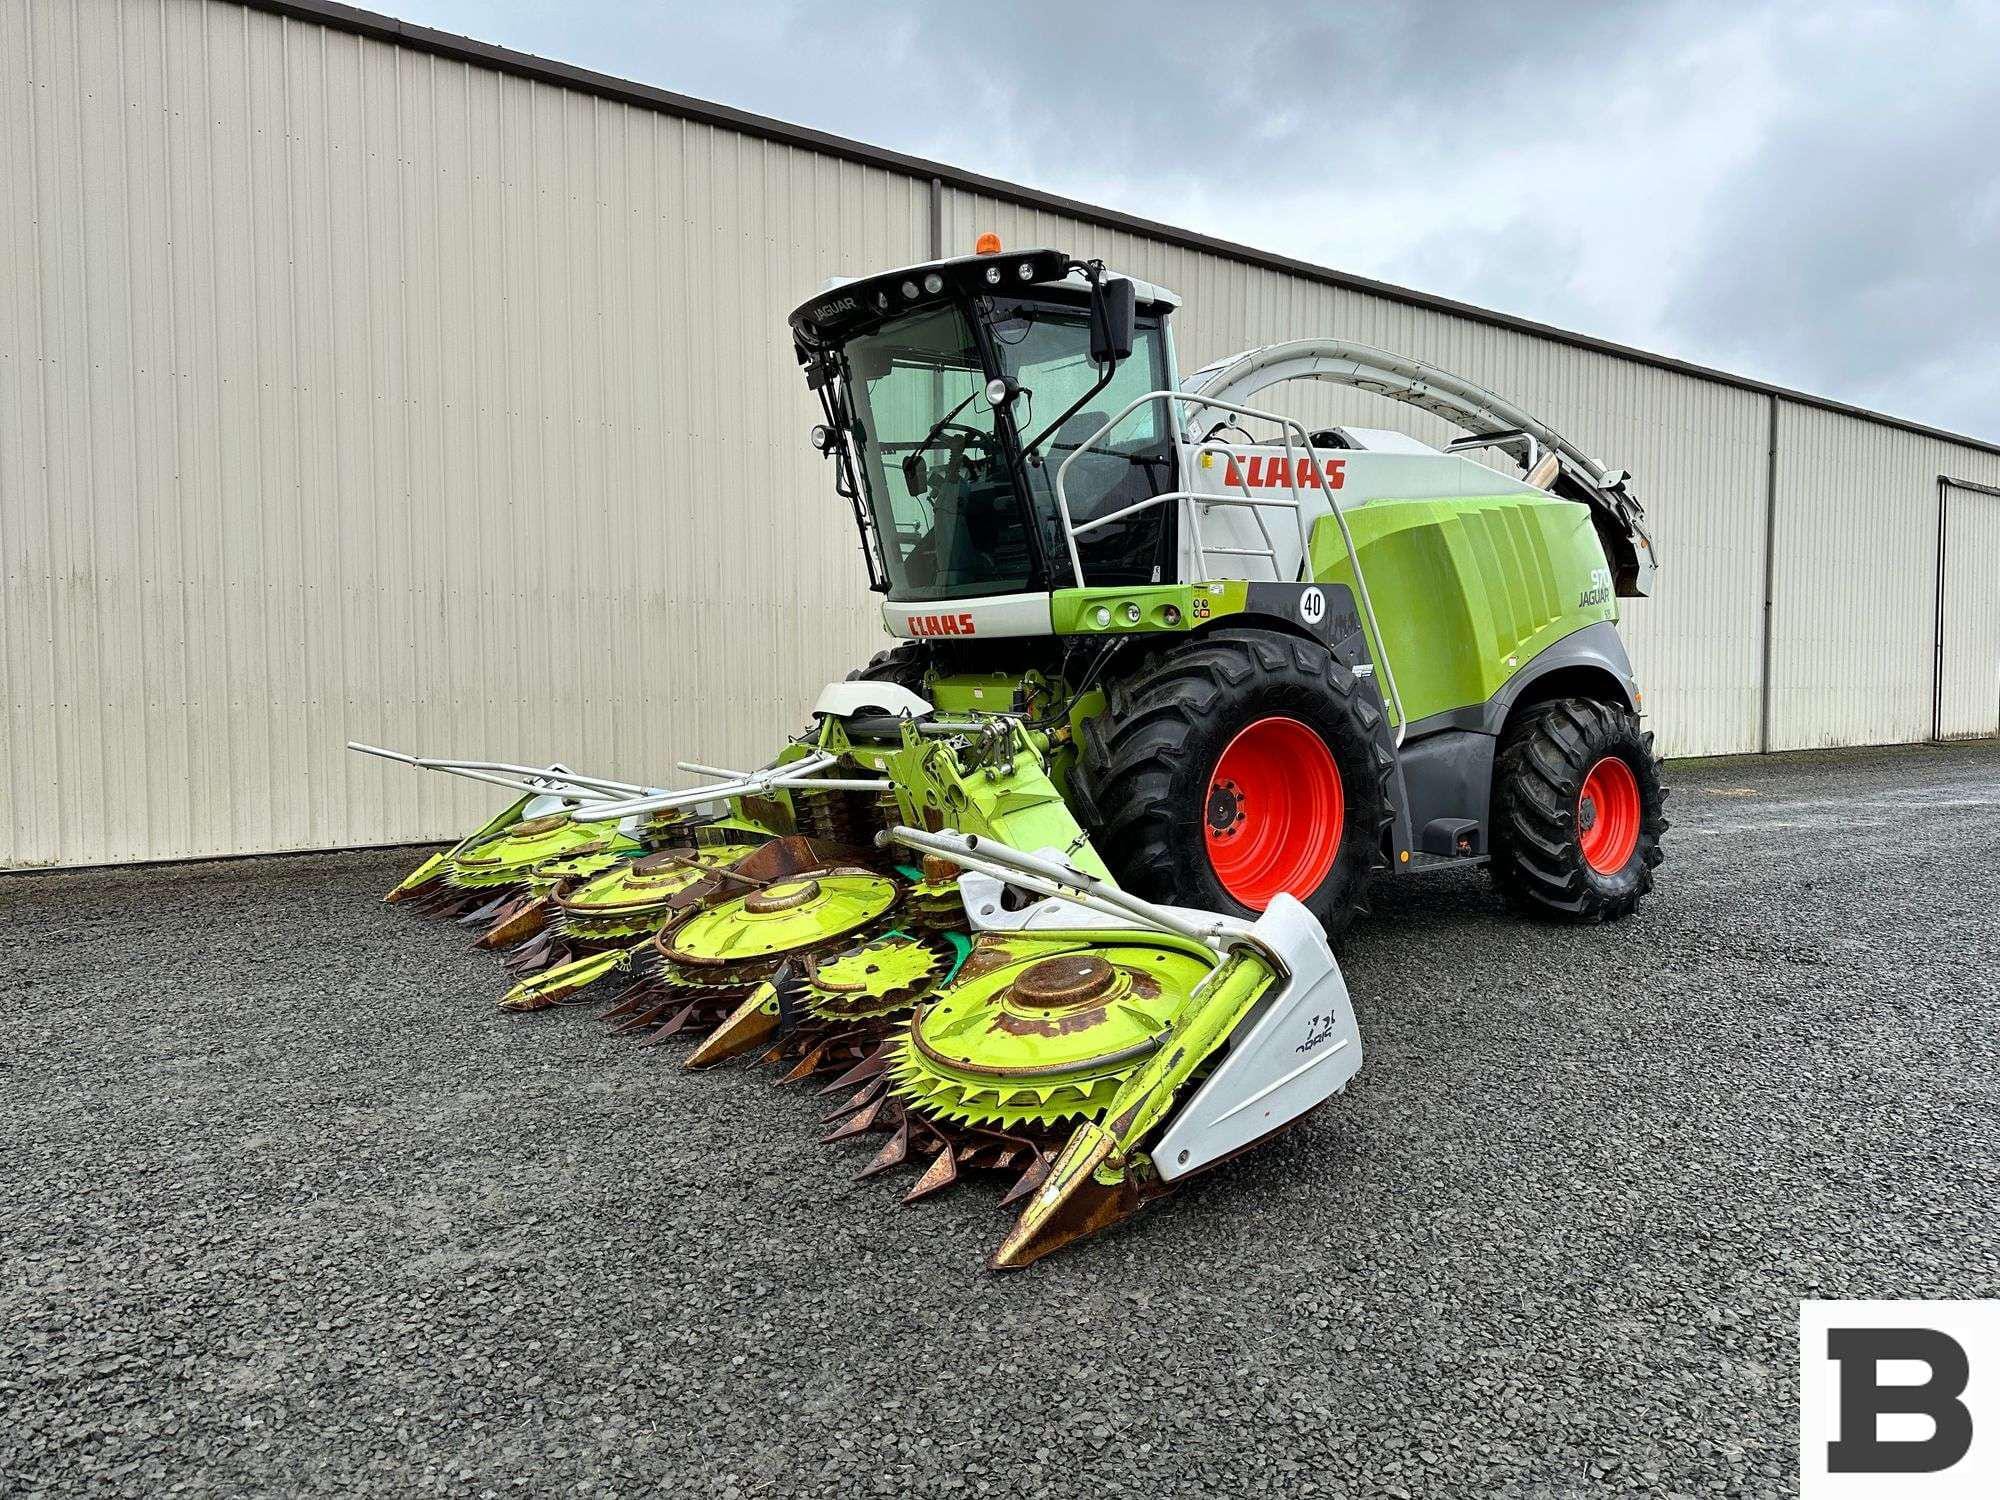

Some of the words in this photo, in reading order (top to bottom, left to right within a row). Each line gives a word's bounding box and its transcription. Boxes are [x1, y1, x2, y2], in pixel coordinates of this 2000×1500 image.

[813, 297, 857, 321] JAGUAR
[1224, 455, 1346, 490] CLAAS
[1304, 593, 1321, 616] 40
[1579, 588, 1610, 608] JAGUAR
[907, 613, 976, 636] CLAAS
